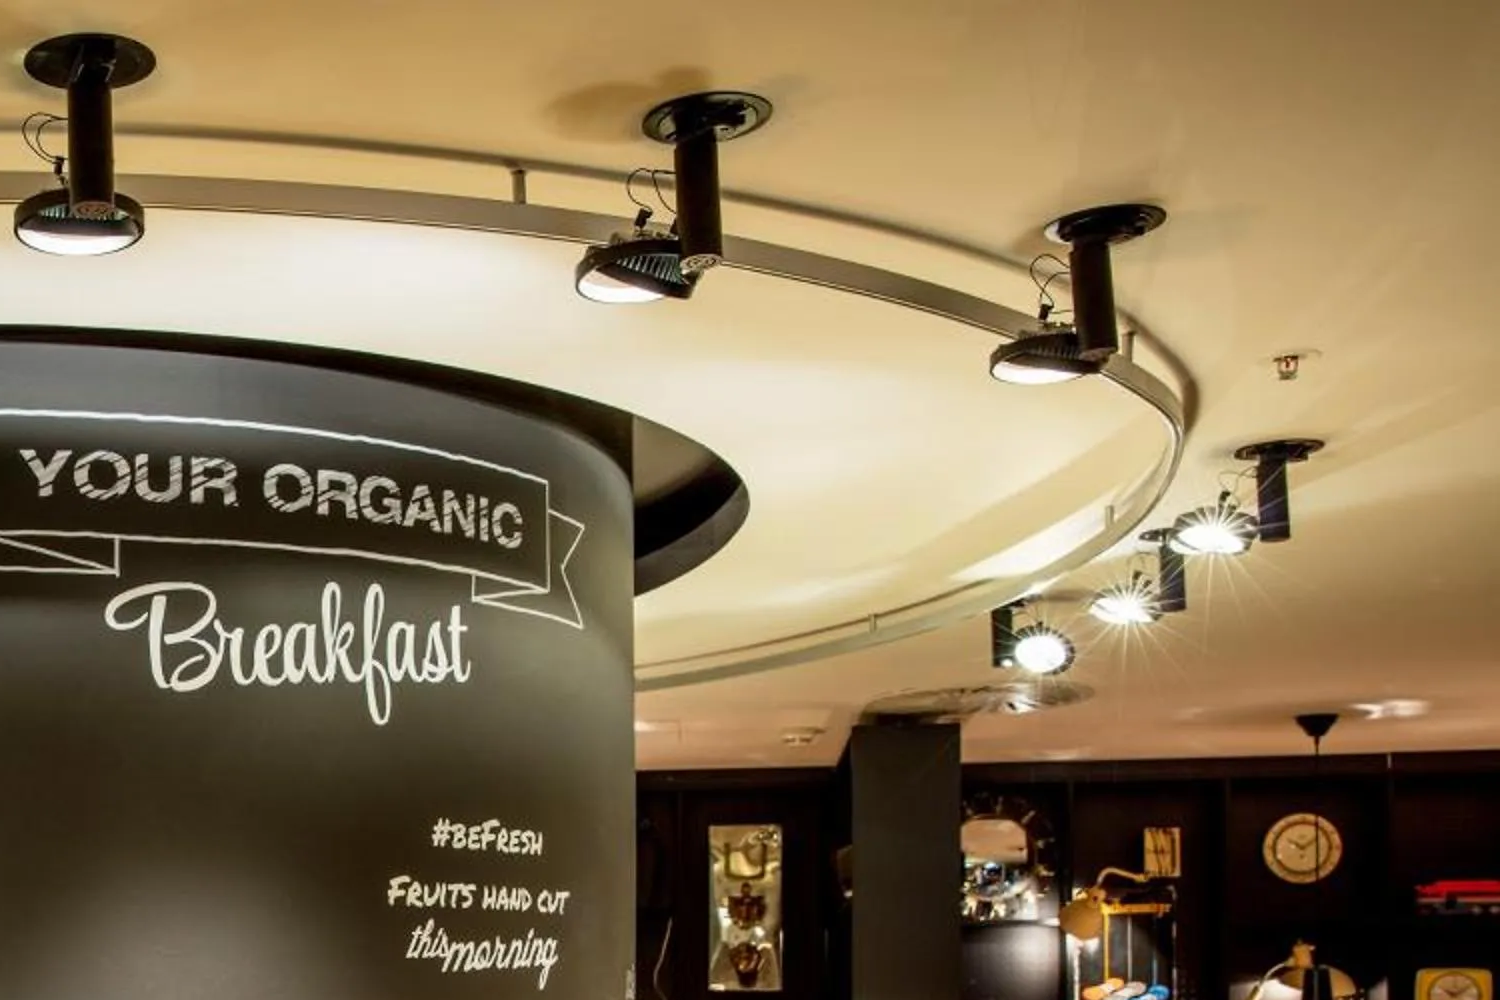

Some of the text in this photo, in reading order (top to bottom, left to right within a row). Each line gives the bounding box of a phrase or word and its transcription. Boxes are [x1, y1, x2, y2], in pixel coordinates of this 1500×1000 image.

[19, 448, 524, 550] YOUR ORGANIC
[104, 581, 472, 726] Breakfast
[481, 885, 533, 913] HAND
[536, 889, 571, 916] CUT
